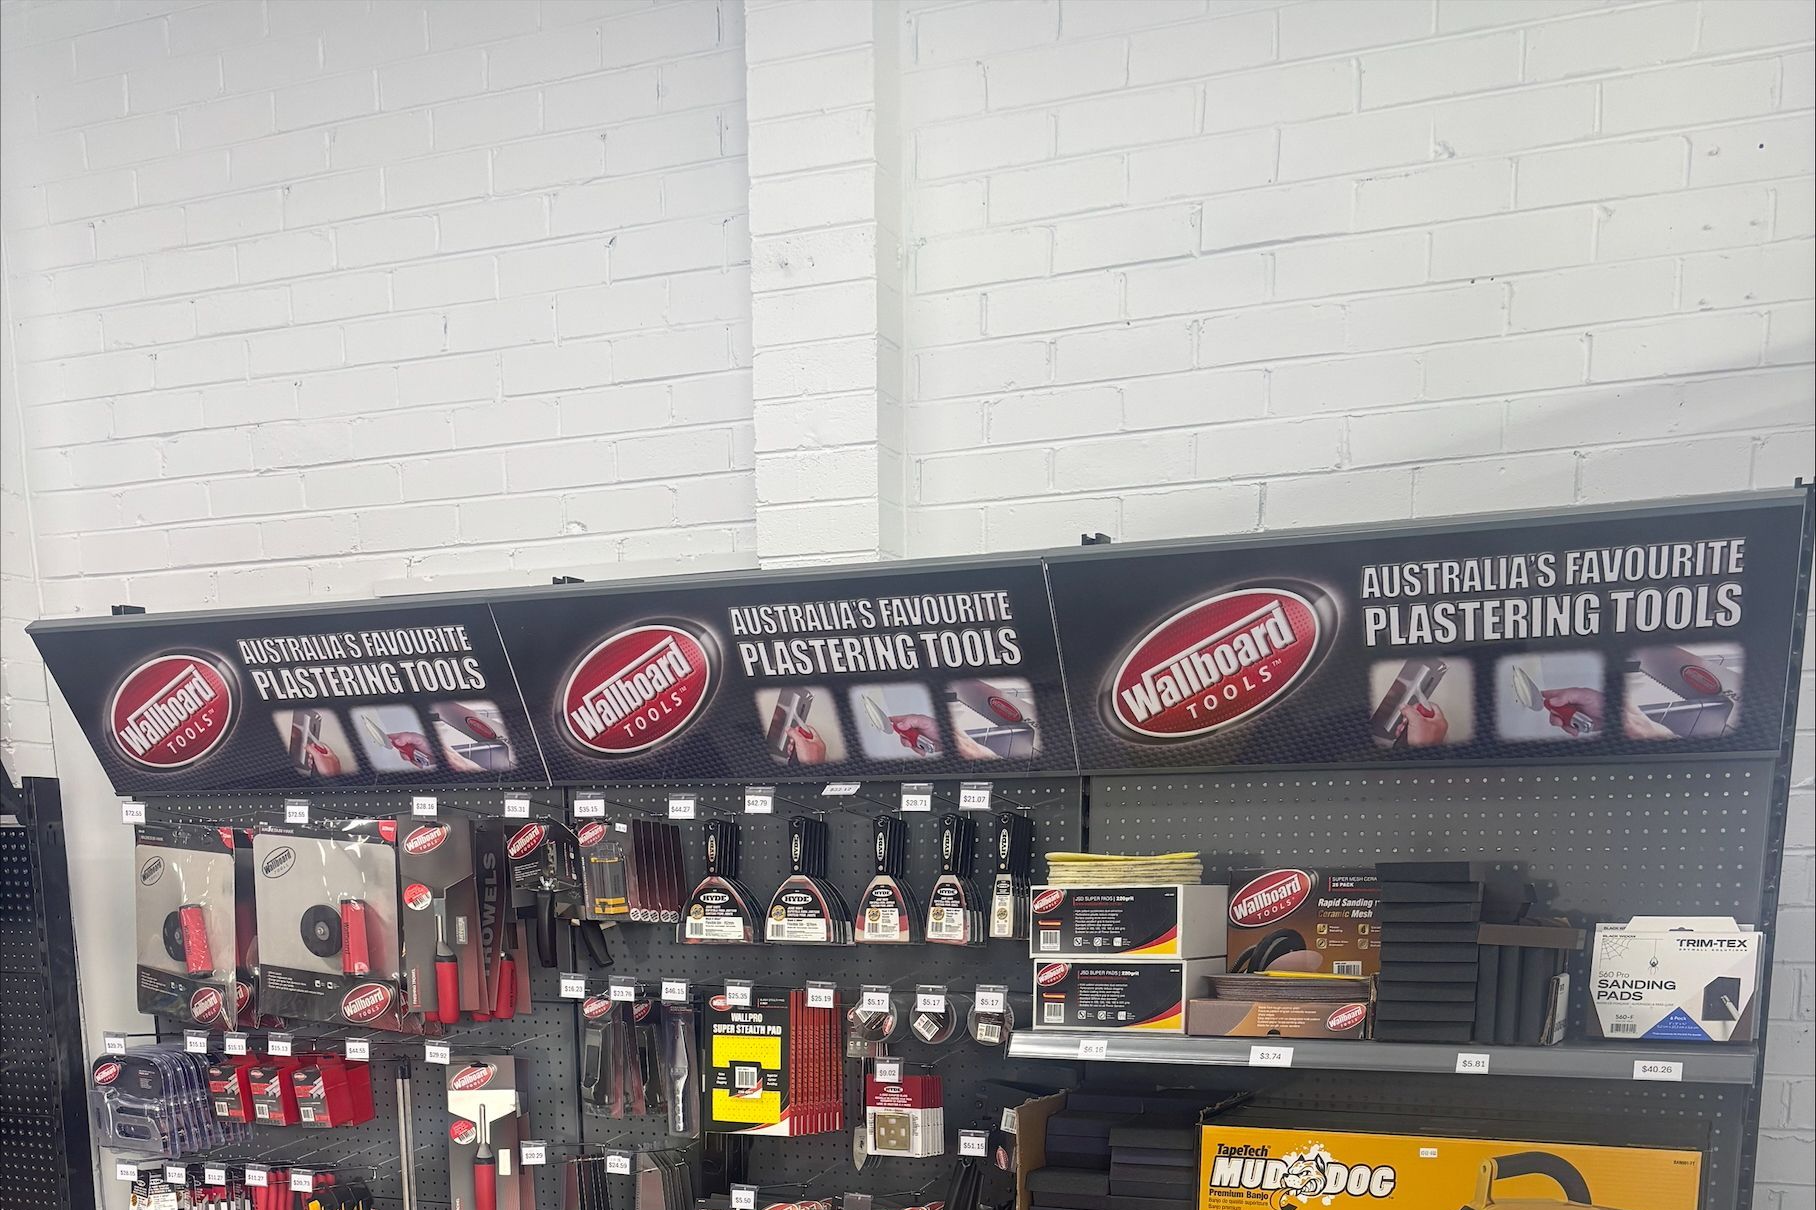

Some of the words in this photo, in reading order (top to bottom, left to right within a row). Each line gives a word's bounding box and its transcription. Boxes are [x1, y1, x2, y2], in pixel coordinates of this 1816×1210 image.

[1361, 555, 1556, 599] AUSTRALIA'S
[1564, 538, 1746, 583] FAVOURITE
[729, 600, 875, 636] AUSTRALIA'S
[879, 591, 1012, 627] FAVOURITE
[1363, 593, 1600, 646] PLASTERING
[1609, 583, 1743, 632] TOOLS
[238, 631, 361, 664] AUSTRALIA'S
[361, 625, 472, 658] FAVOURITE
[737, 633, 919, 677] PLASTERING
[918, 627, 1022, 667] TOOLS
[1120, 600, 1297, 723] Wallboard
[251, 662, 402, 700] PLASTERING
[401, 657, 486, 693] TOOLS
[571, 635, 693, 740] Wallboard
[119, 664, 218, 756] Wallboard
[747, 799, 768, 807] $42.79
[905, 799, 928, 807] $28.71
[963, 795, 986, 804] $21.07
[288, 810, 306, 818] $72.55
[671, 805, 691, 813] $44.27
[406, 827, 442, 852] Wallboard
[508, 825, 540, 856] Wallboard
[264, 849, 292, 875] Wallboard
[1233, 874, 1302, 920] Wallboard
[1257, 898, 1291, 920] TOOLS
[1318, 898, 1340, 908] Rapid
[1341, 898, 1373, 909] Sanding
[1318, 909, 1349, 918] Ceramic
[1351, 909, 1373, 918] Mesh
[1676, 938, 1748, 948] TRIM-TEX
[1616, 971, 1630, 979] Pro
[1598, 979, 1676, 990] SANDING
[728, 992, 748, 1000] $25.35
[1597, 990, 1643, 1001] PADS
[344, 987, 385, 1017] Wallboard
[867, 998, 885, 1006] $5.17
[922, 998, 940, 1006] $5.17
[981, 998, 999, 1006] $5.17
[731, 1012, 763, 1023] WALLPRO
[1328, 1006, 1363, 1028] Wallboard
[713, 1024, 736, 1034] SUPER
[735, 1024, 765, 1035] STEALTH
[766, 1026, 782, 1035] PAD
[1259, 1052, 1281, 1060] $3.74
[1462, 1059, 1486, 1068] $5.81
[1641, 1064, 1673, 1074] $40.26
[453, 1066, 493, 1091] Wallboard
[1217, 1143, 1268, 1157] TapeTech
[1210, 1156, 1288, 1190] MUD
[1323, 1161, 1396, 1198] DOG
[1208, 1188, 1244, 1199] Premium
[1246, 1191, 1269, 1201] Banjo
